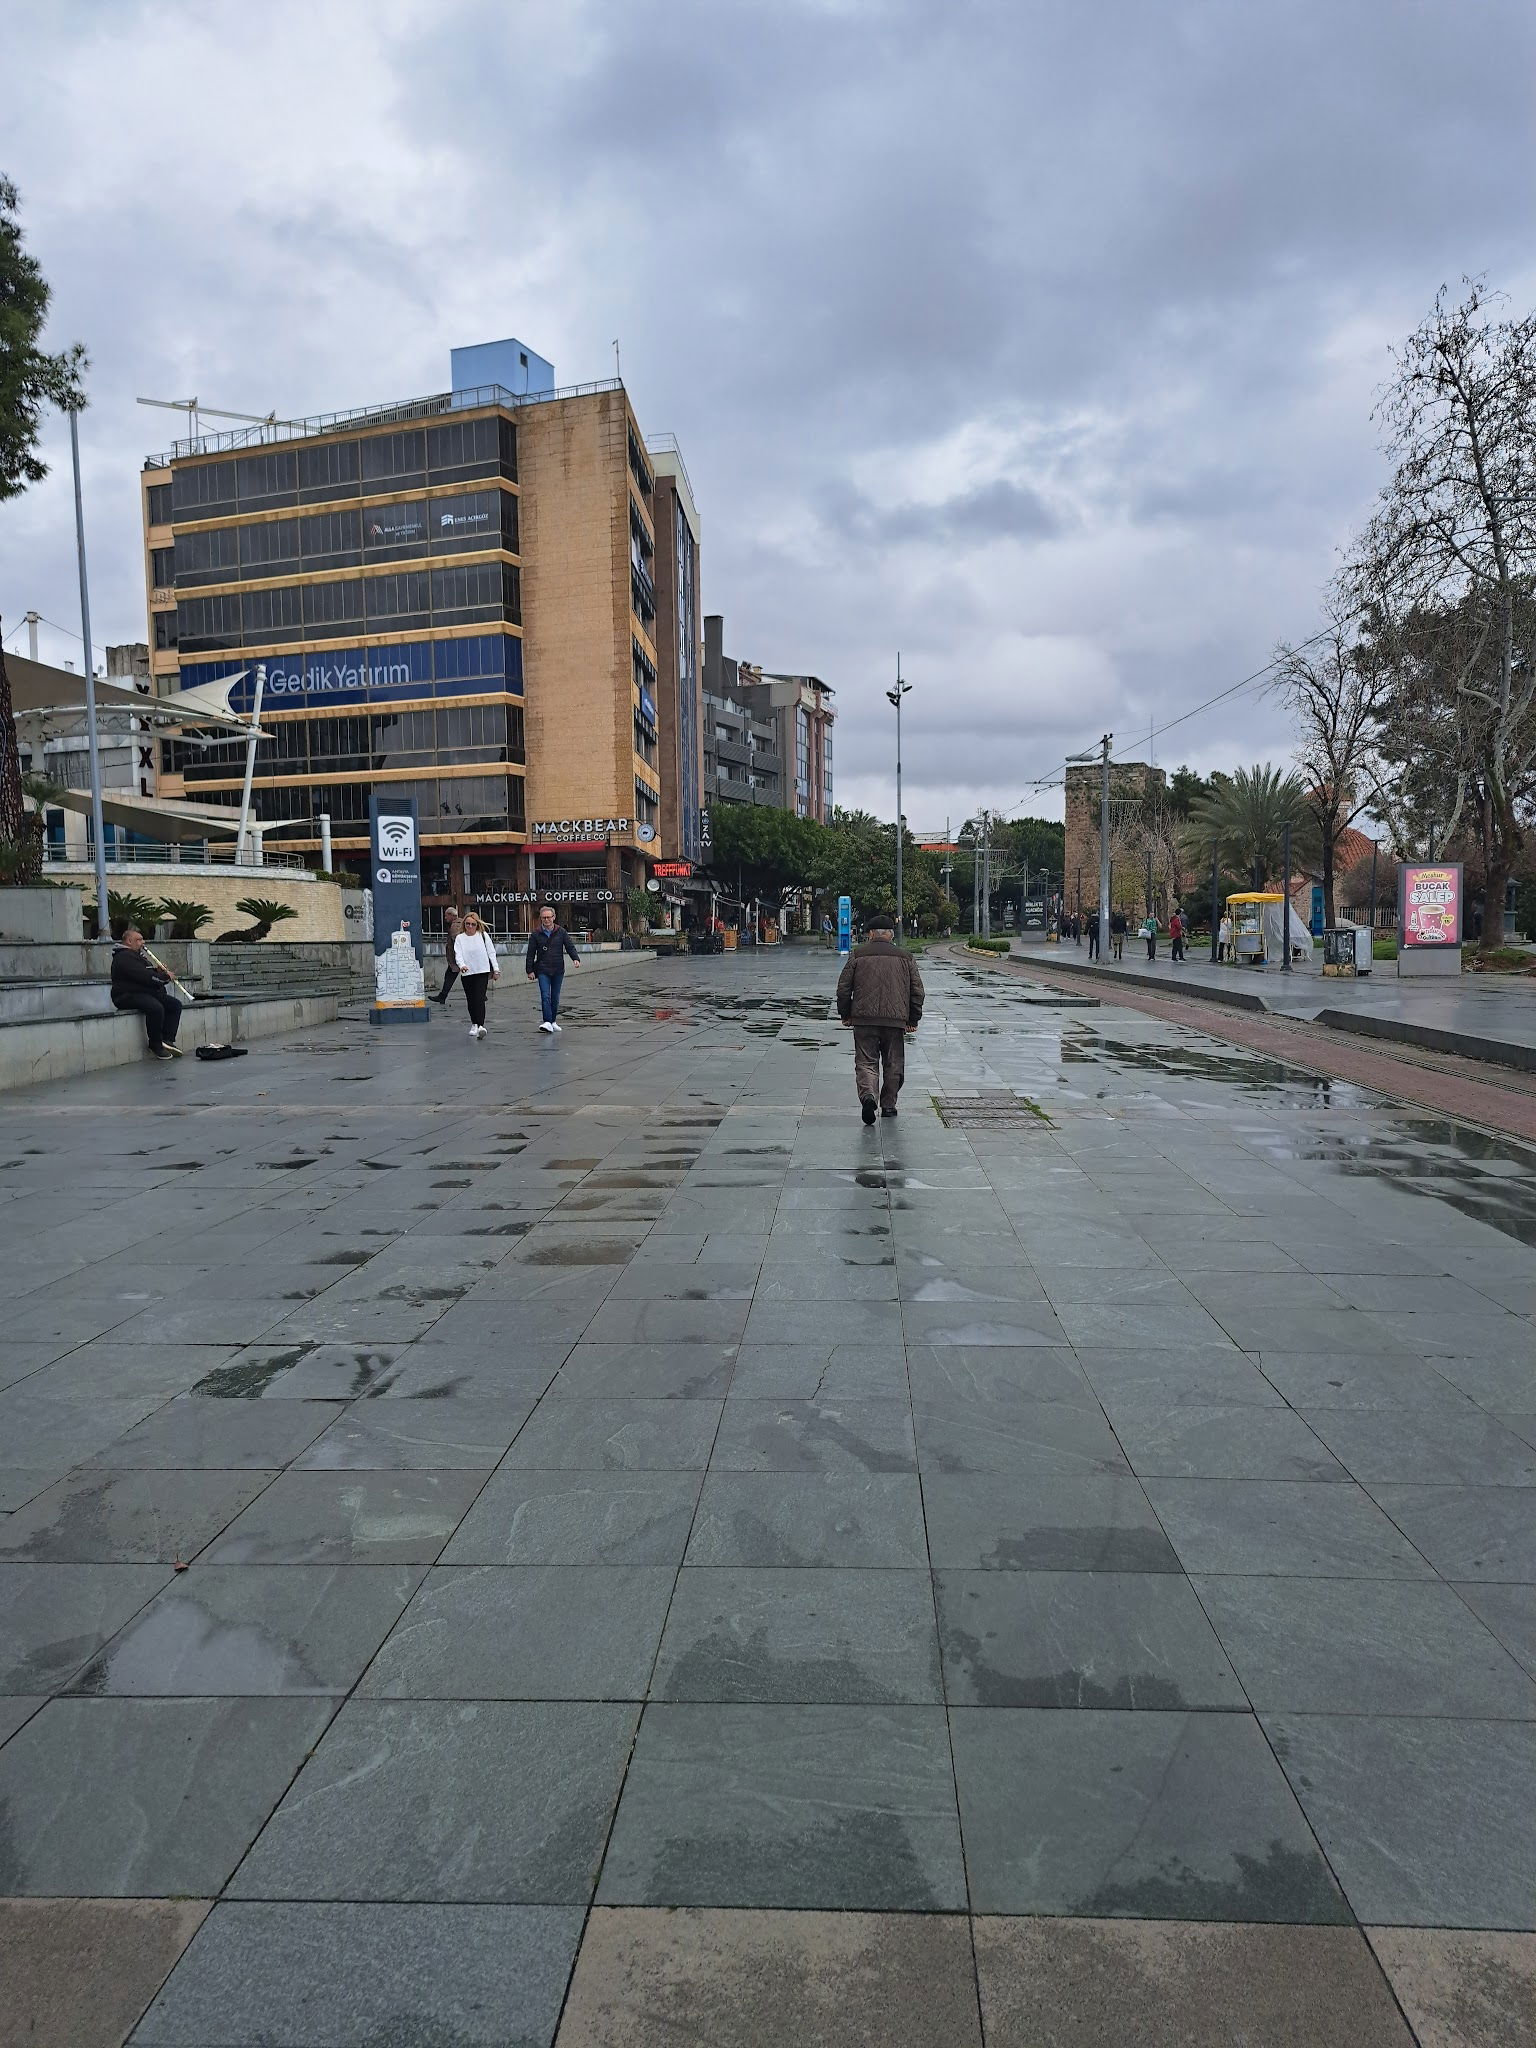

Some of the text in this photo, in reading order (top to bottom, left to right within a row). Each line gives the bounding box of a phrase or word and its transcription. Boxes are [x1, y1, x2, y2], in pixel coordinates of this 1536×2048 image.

[534, 818, 629, 834] MACKBEAR
[556, 833, 592, 842] COFFEE
[382, 847, 412, 857] Wi-Fi
[476, 890, 615, 903] MACKBEAR COFFEE CO.
[1410, 891, 1455, 903] SALEP
